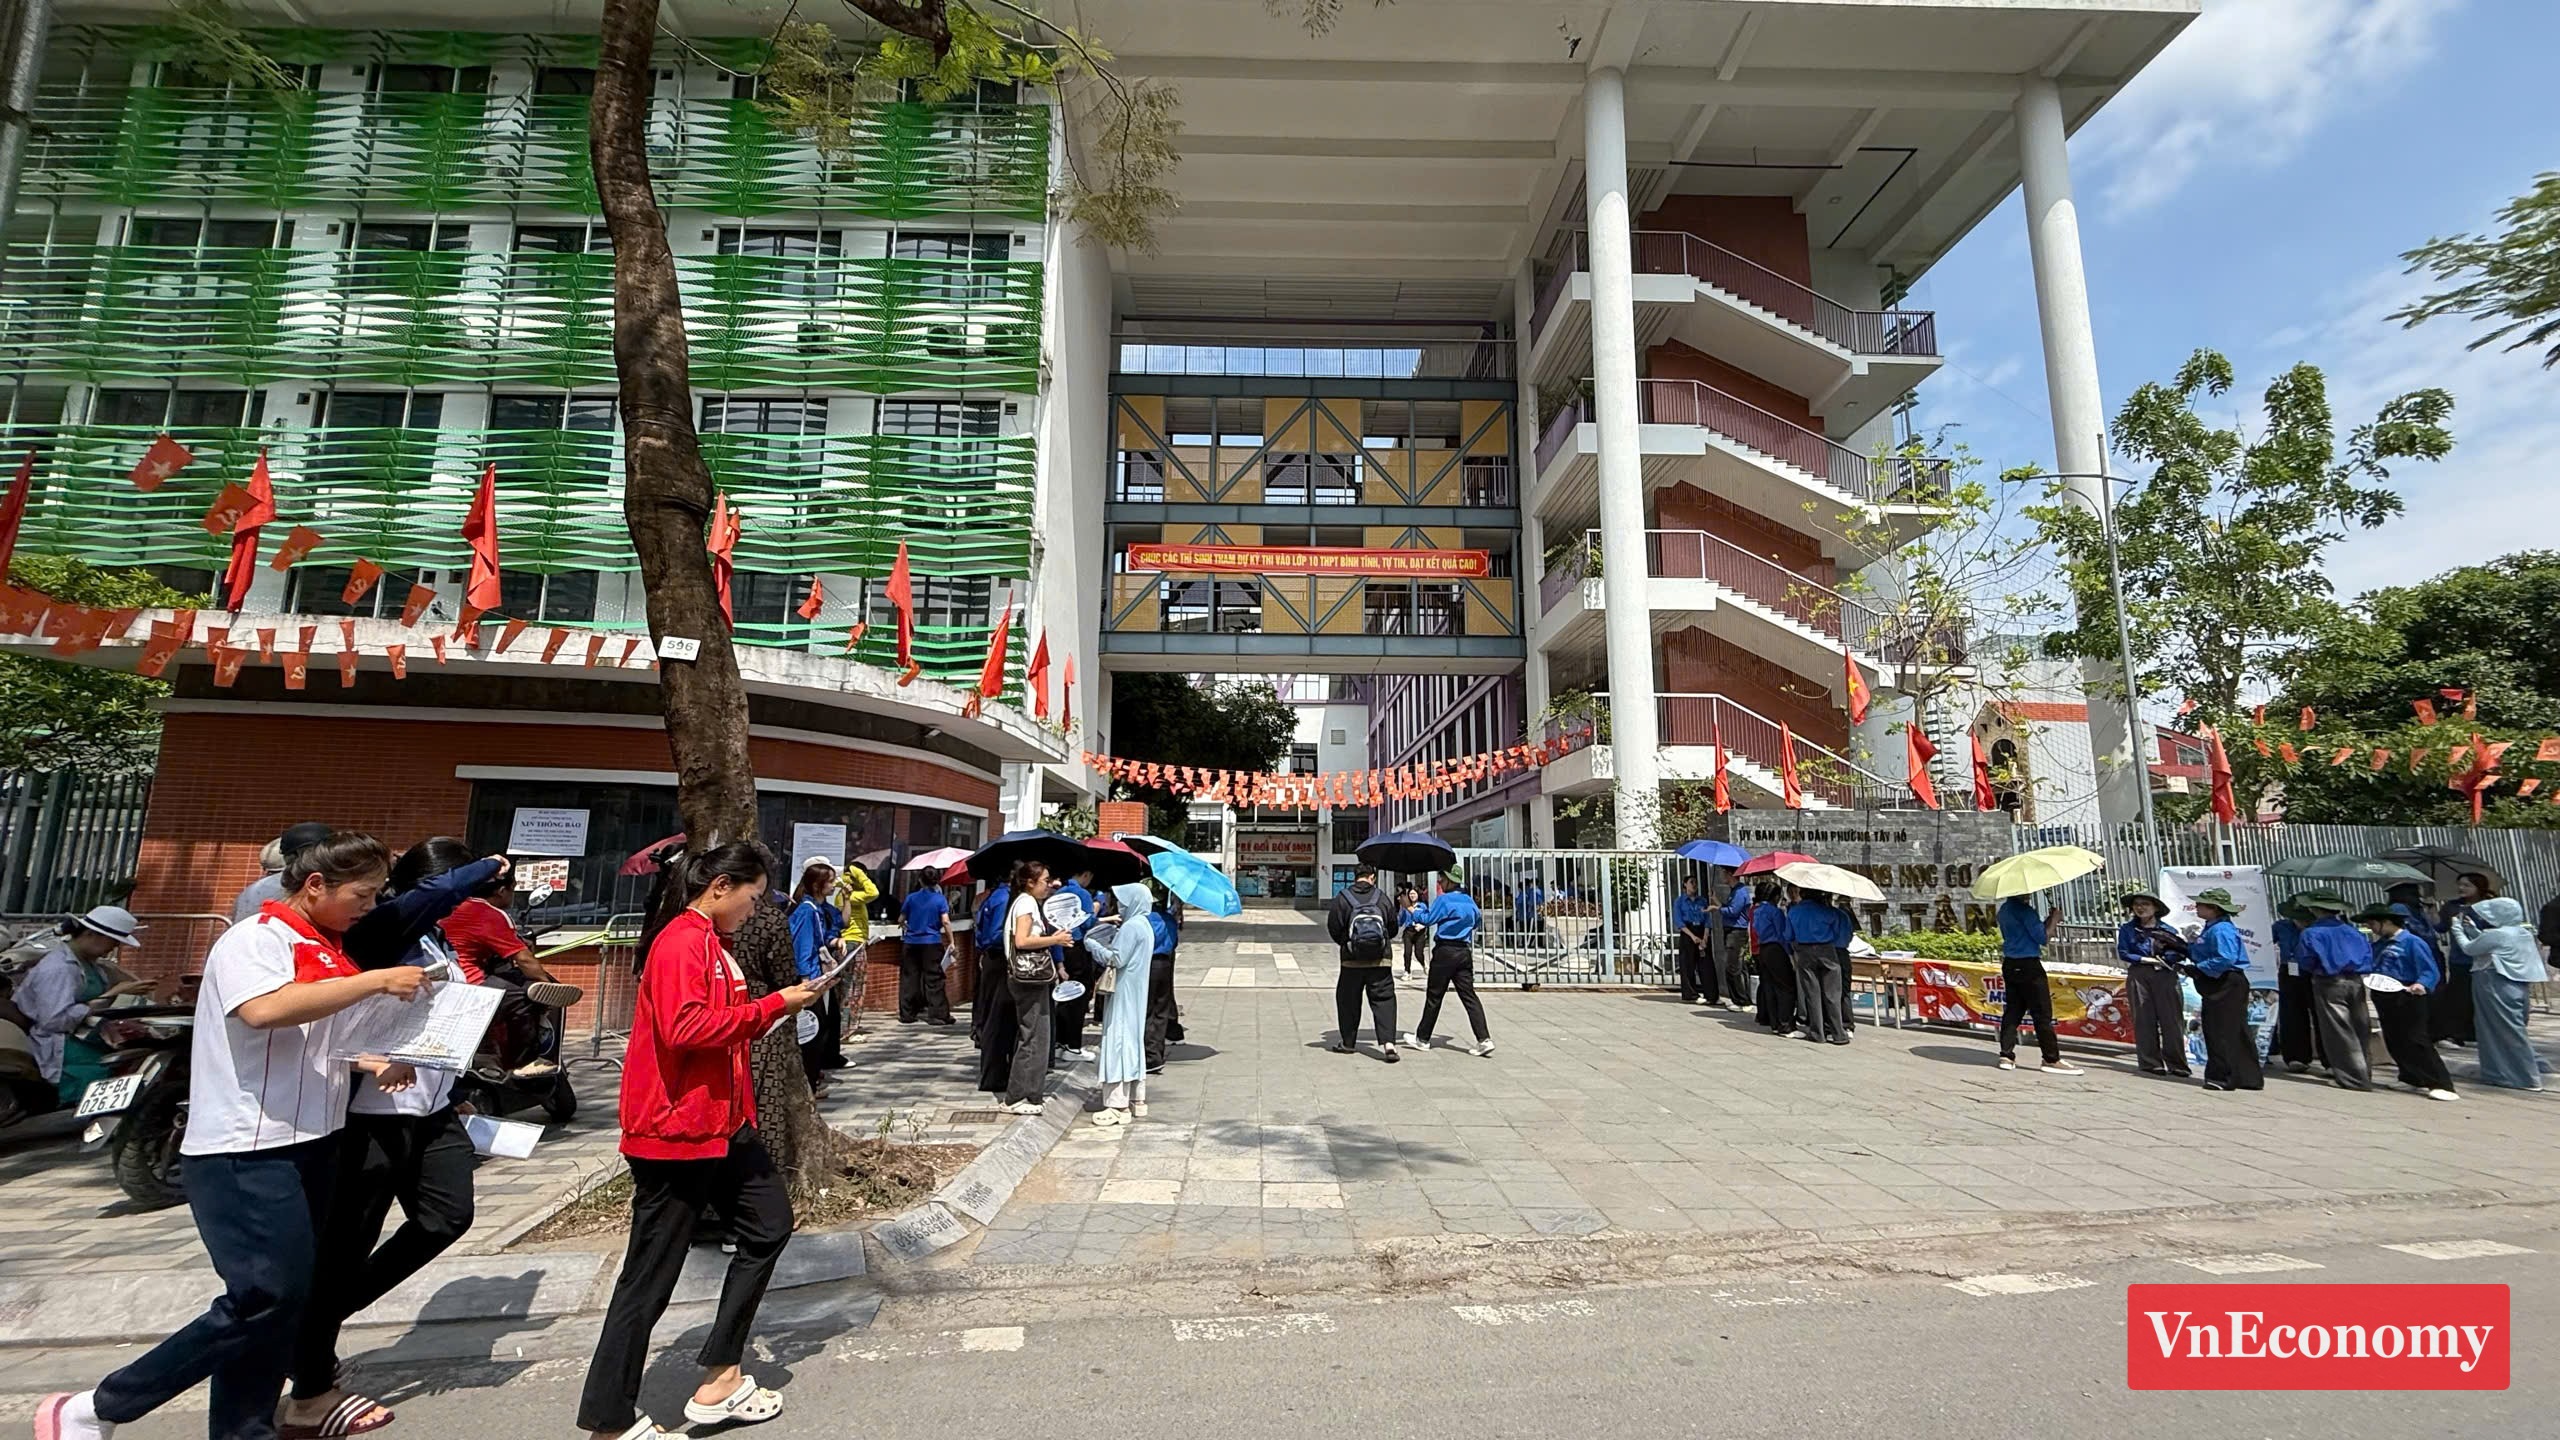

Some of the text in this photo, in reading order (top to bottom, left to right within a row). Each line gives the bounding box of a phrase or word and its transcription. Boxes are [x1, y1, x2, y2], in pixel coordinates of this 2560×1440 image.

[1140, 551, 1161, 564] CHÚC
[1162, 551, 1178, 563] CÁC
[1180, 551, 1193, 563] THÍ
[1193, 553, 1213, 564] SINH
[1214, 553, 1236, 565] THAM
[1237, 553, 1249, 567] DỰ
[1261, 554, 1274, 566] THI
[1275, 552, 1291, 566] VÀO
[1292, 553, 1307, 566] LỚP
[1309, 556, 1319, 566] 10
[1320, 556, 1339, 567] THPT
[1340, 554, 1359, 567] BÌNH
[1382, 556, 1393, 570] TỰ
[1426, 555, 1440, 569] KẾT
[1442, 555, 1457, 570] QUẢ
[1458, 558, 1477, 570] CAO!
[666, 640, 694, 652] 596
[1755, 829, 1775, 841] BAN
[1778, 827, 1805, 841] NHÂN
[1807, 828, 1829, 842] DÂN
[1830, 827, 1871, 842] PHƯỜNG
[1874, 828, 1890, 842] TÂY
[1900, 863, 1938, 893] HỌC
[1944, 862, 1972, 888] CƠ
[1919, 967, 1970, 989] VELA
[90, 1077, 132, 1098] 29-BA
[80, 1091, 130, 1115] 026.21
